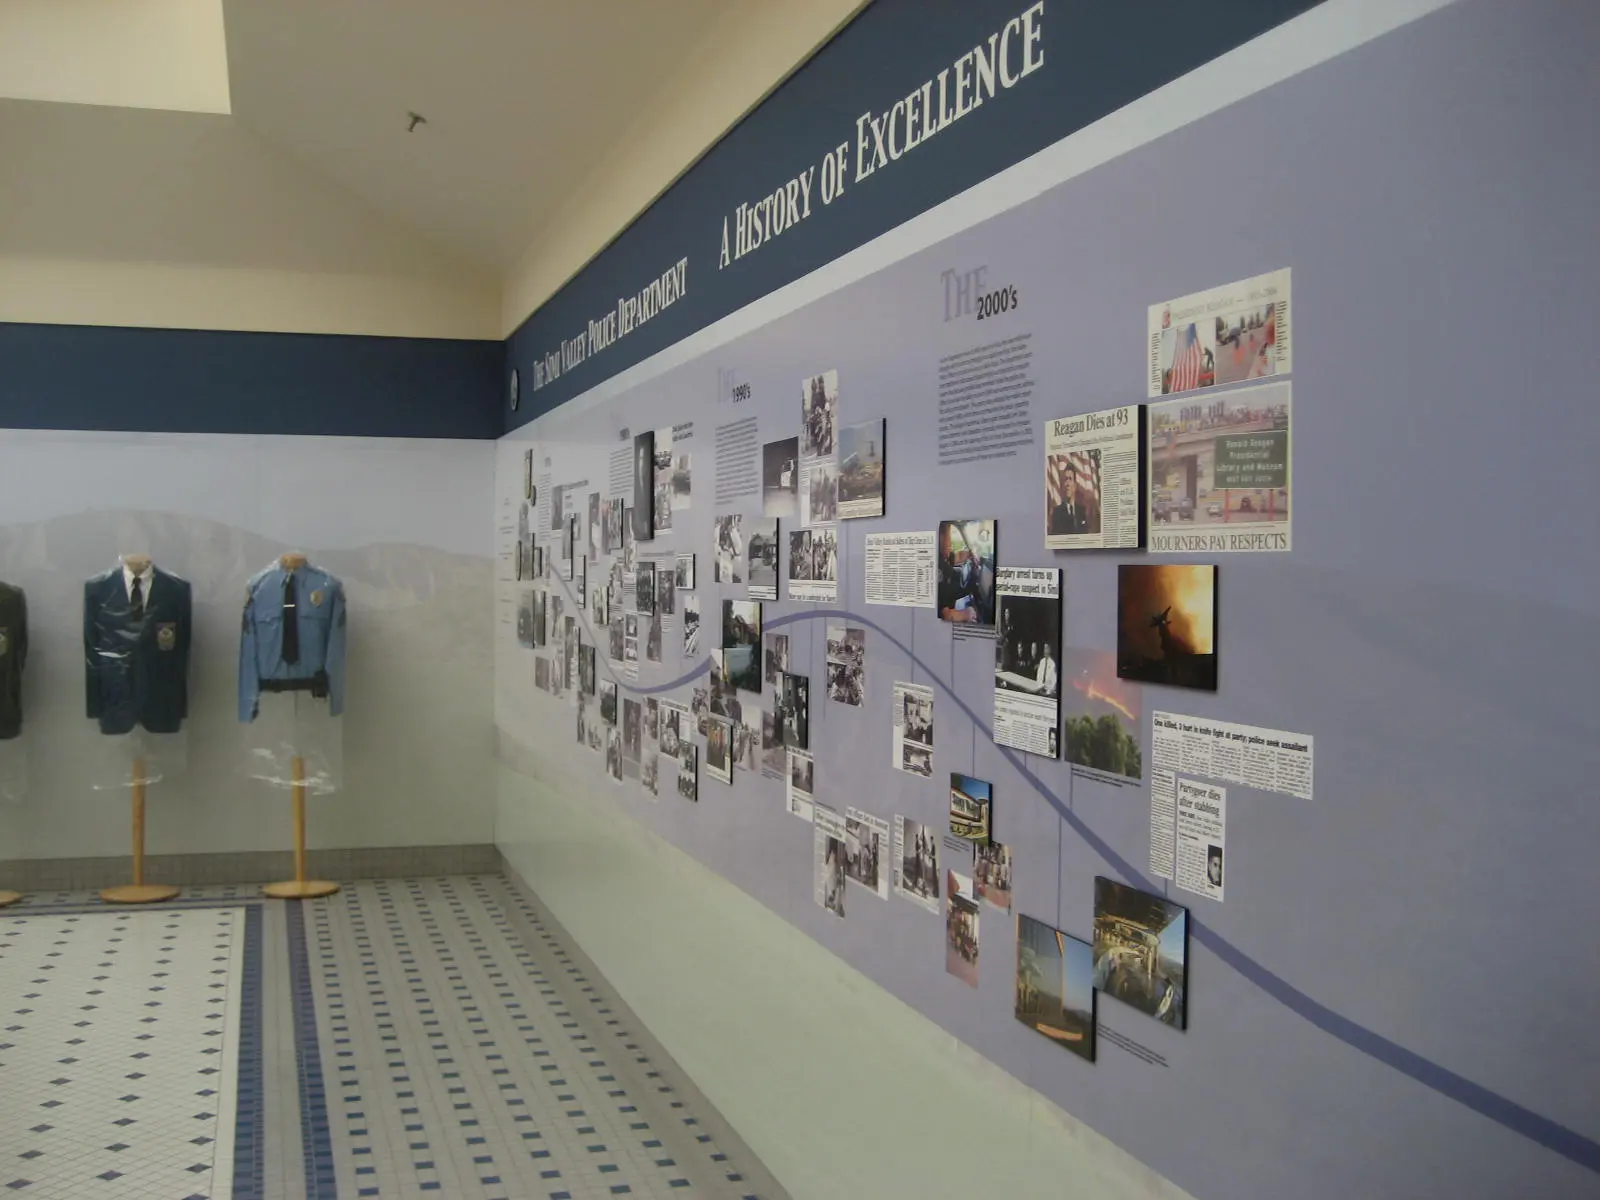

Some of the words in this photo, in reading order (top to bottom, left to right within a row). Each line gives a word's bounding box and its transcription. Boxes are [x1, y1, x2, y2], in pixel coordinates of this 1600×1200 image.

[719, 215, 731, 270] A
[734, 165, 815, 260] HISTORY
[821, 141, 849, 205] OF
[855, 1, 1045, 183] EXCELLENCE
[587, 309, 617, 357] POLICE
[618, 256, 688, 339] DEPARTMENT
[976, 284, 1018, 321] 2000's
[732, 382, 751, 404] 1990's
[1054, 420, 1085, 438] Reagan
[1086, 413, 1105, 431] Dies
[1106, 415, 1115, 428] at
[1116, 408, 1129, 426] 93
[1151, 534, 1208, 551] MOURNERS
[1209, 534, 1229, 550] PAY
[1230, 532, 1287, 550] RESPECTS
